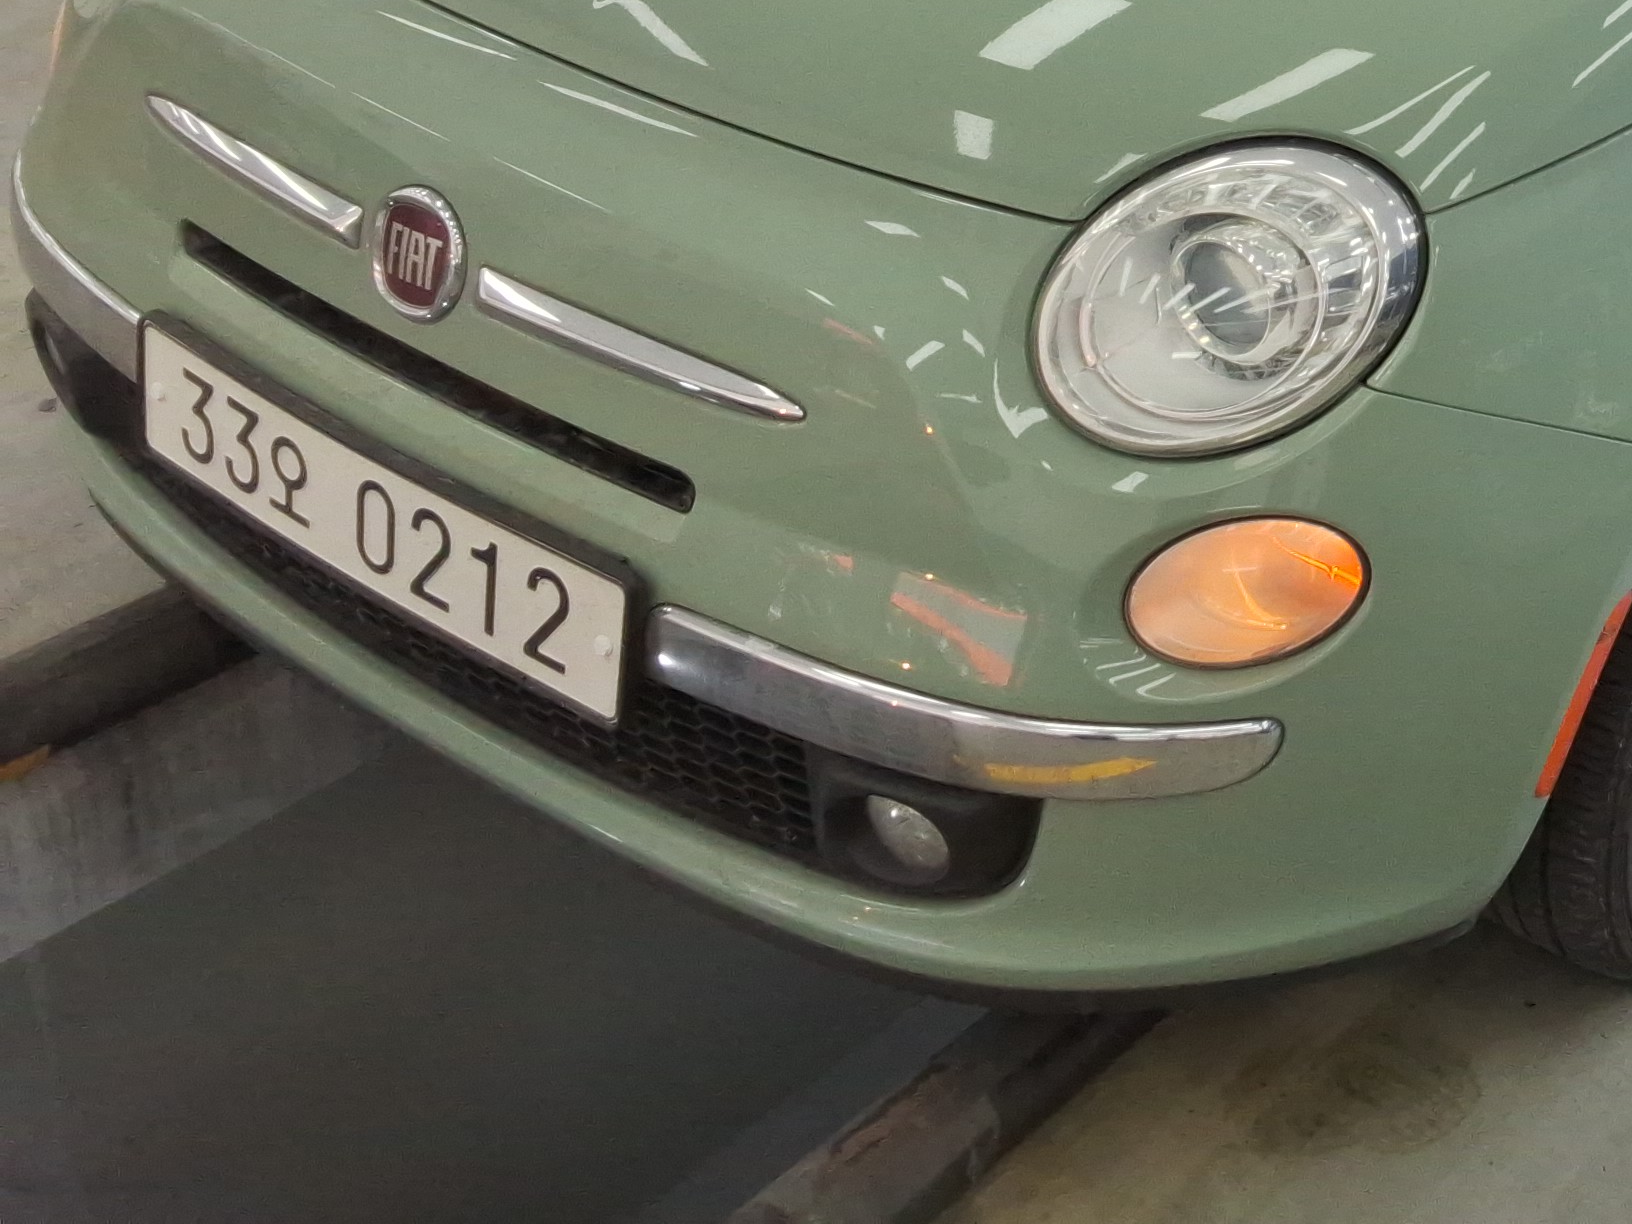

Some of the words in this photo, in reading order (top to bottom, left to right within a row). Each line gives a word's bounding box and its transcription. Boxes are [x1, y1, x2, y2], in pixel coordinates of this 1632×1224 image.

[386, 221, 443, 291] FIAT
[181, 367, 310, 529] 33오
[356, 479, 570, 675] 0212
